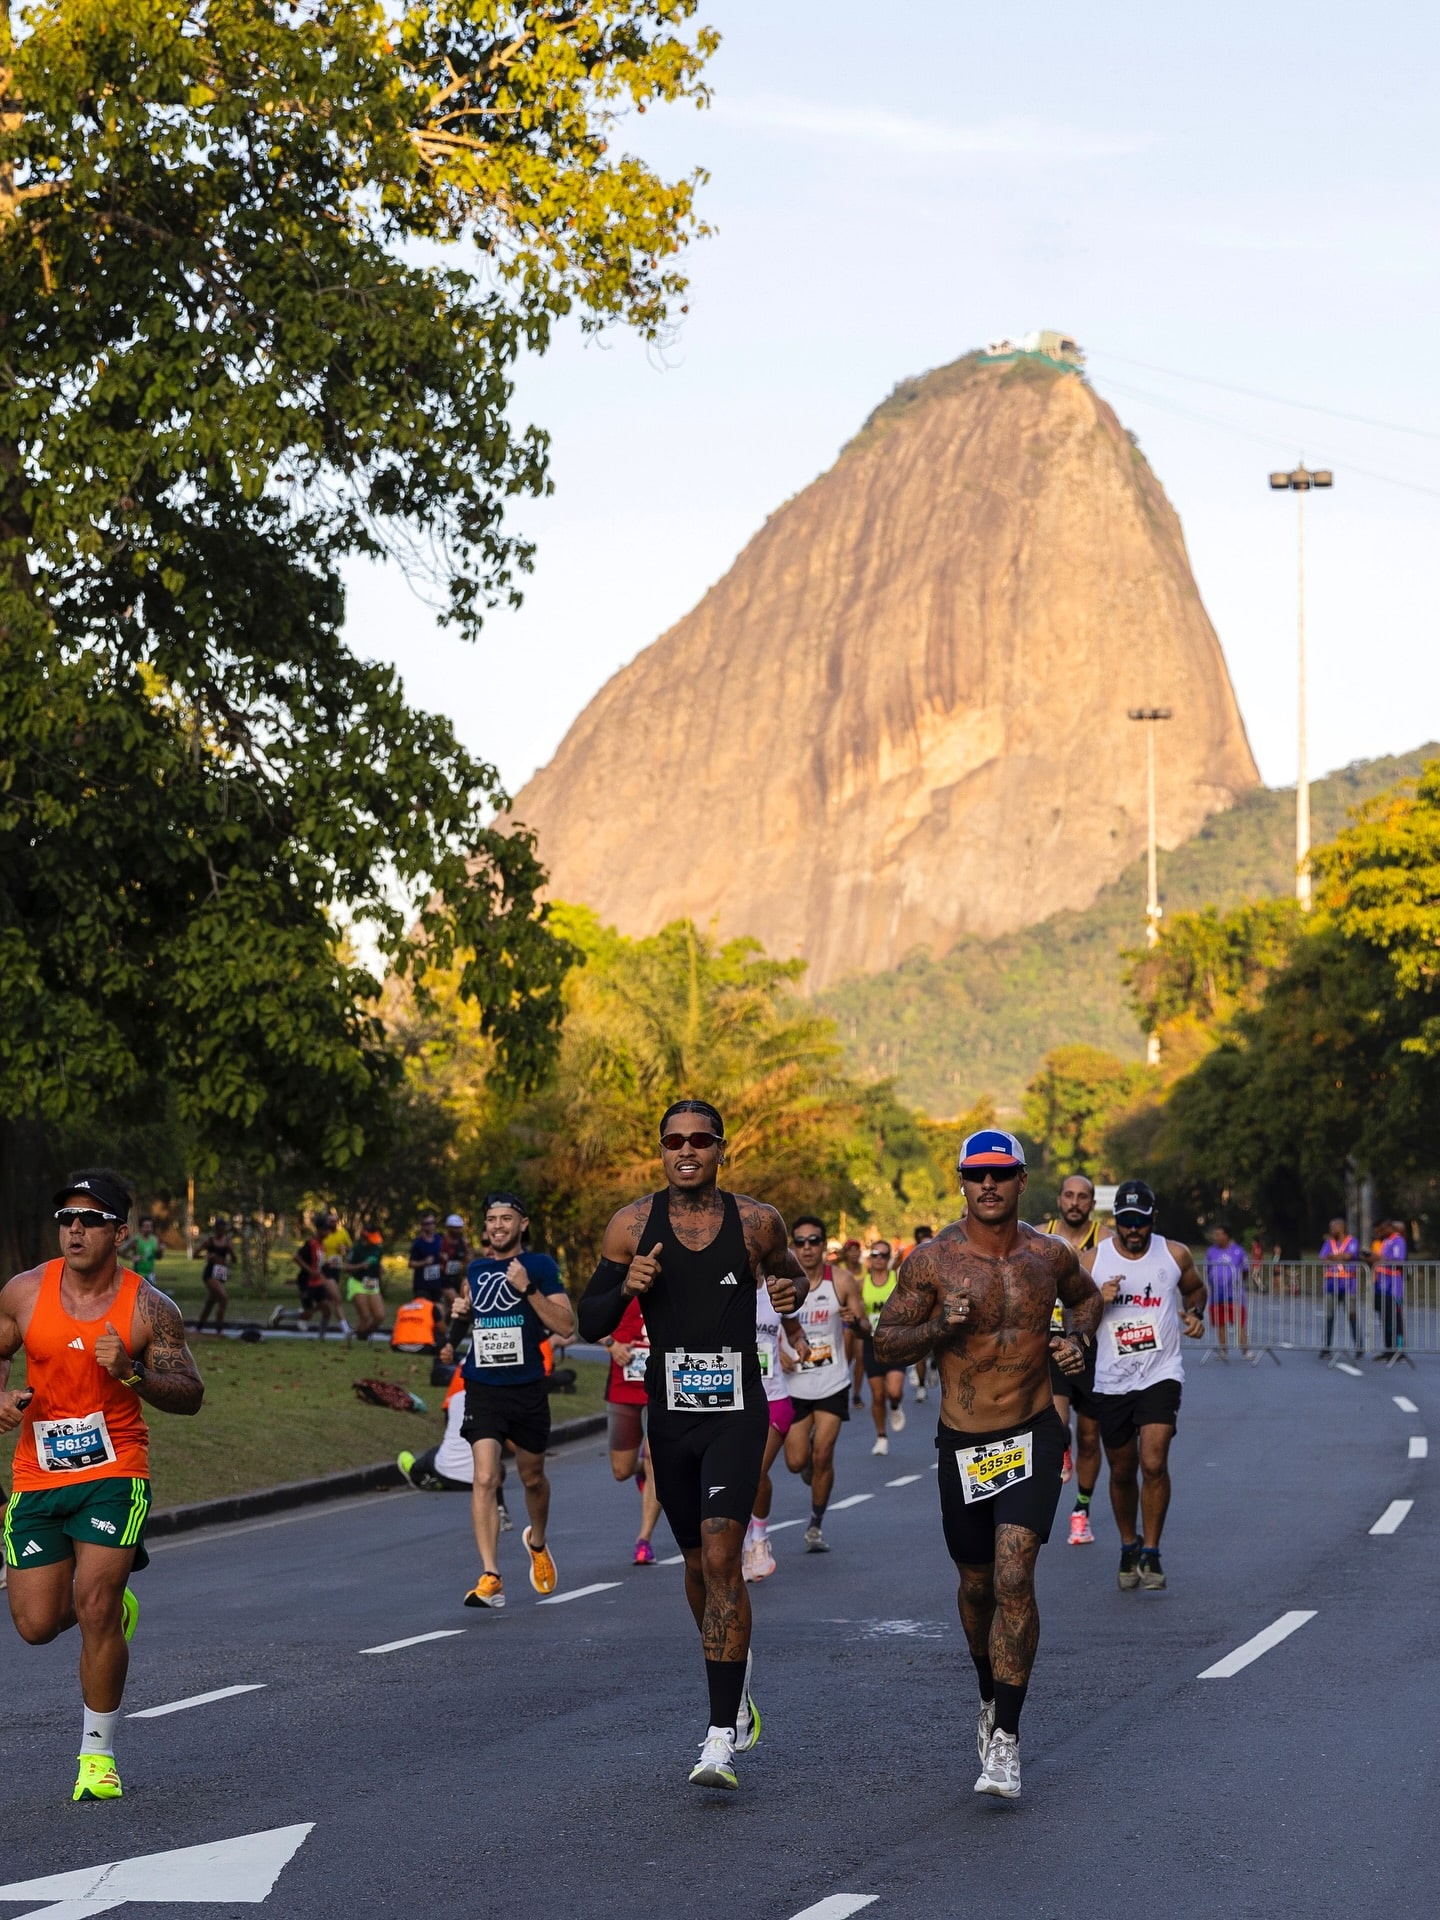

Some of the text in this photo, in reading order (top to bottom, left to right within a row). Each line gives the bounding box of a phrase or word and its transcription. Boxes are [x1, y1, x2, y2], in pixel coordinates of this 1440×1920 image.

[810, 1310, 830, 1325] LIMA
[485, 1341, 516, 1351] 52828
[682, 1373, 733, 1387] 53909
[56, 1433, 98, 1452] 56131
[980, 1451, 1022, 1476] 53536
